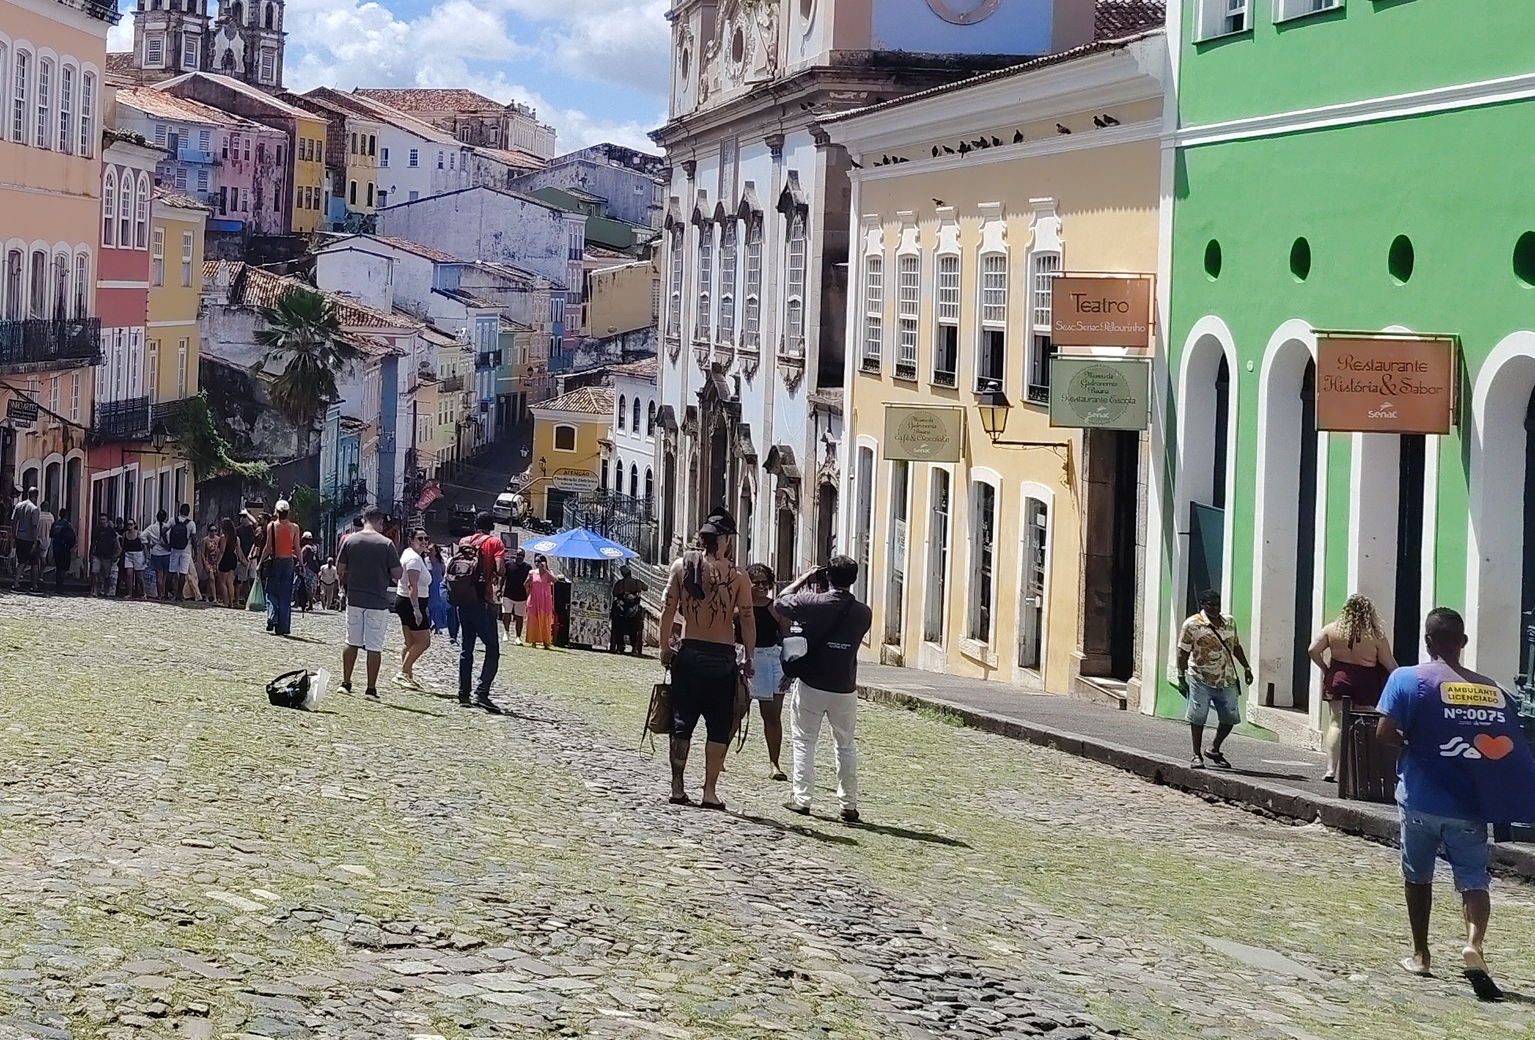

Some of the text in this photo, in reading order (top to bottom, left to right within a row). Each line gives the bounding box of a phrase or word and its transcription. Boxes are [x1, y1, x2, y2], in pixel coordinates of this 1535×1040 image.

[1069, 293, 1130, 314] Teatro
[1055, 320, 1146, 333] Sesc Senac Pelourinho
[1337, 353, 1428, 373] Restaurante
[1323, 373, 1444, 395] História & Sabor
[1061, 393, 1136, 405] Restaurante Escola
[1367, 410, 1398, 419] senac
[1447, 686, 1498, 697] AMBULANTE
[1447, 694, 1499, 704] LICENCIADO
